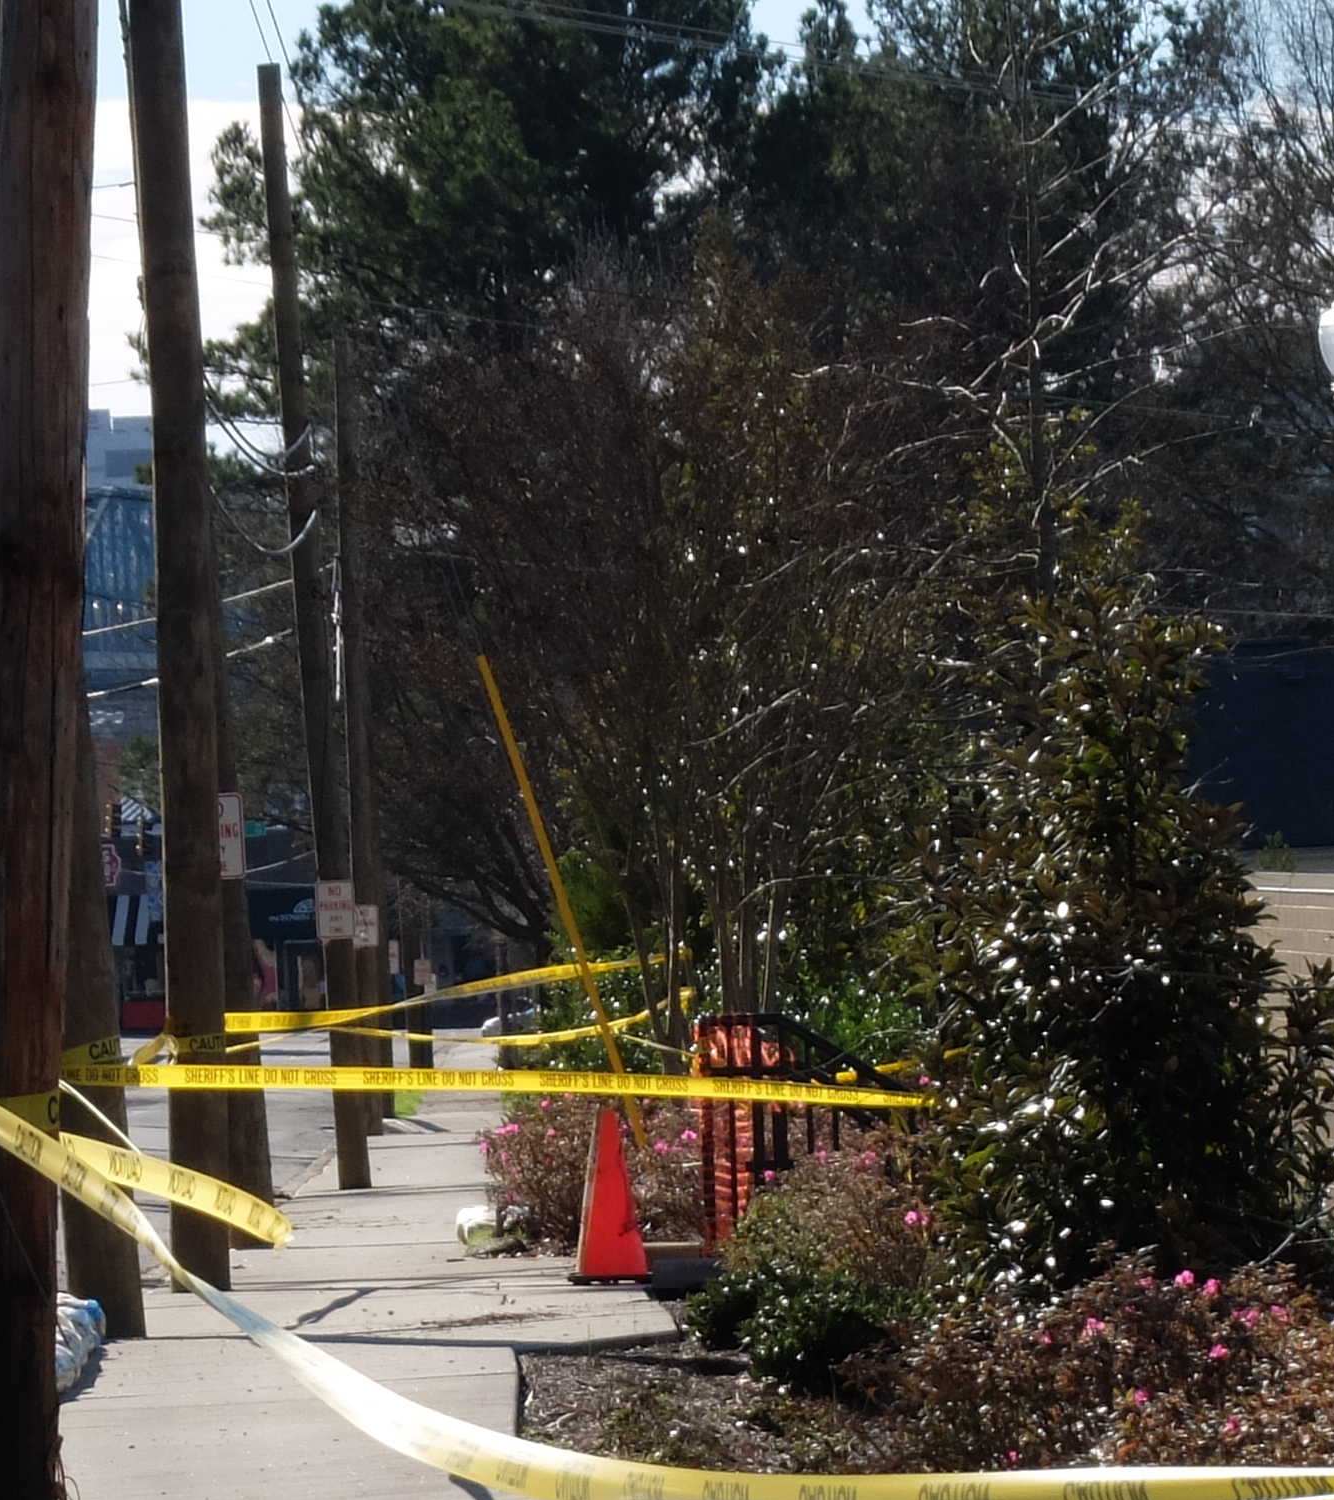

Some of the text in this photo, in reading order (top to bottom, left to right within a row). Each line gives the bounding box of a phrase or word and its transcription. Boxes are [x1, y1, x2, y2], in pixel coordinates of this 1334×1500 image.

[327, 885, 342, 896] NO
[85, 1068, 100, 1081] DO
[102, 1068, 121, 1082] NOT
[124, 1069, 159, 1084] CROSS
[184, 1070, 337, 1086] SHERIFF'S LINE DO NOT CROSS
[362, 1070, 514, 1087] SHERIFF'S LINE DO NOT CROSS
[539, 1073, 689, 1092] SHERIFF'S LINE DO NOT CROSS
[712, 1078, 763, 1096] SHERIFF'S
[766, 1082, 786, 1096] LINE
[789, 1084, 802, 1098] DO
